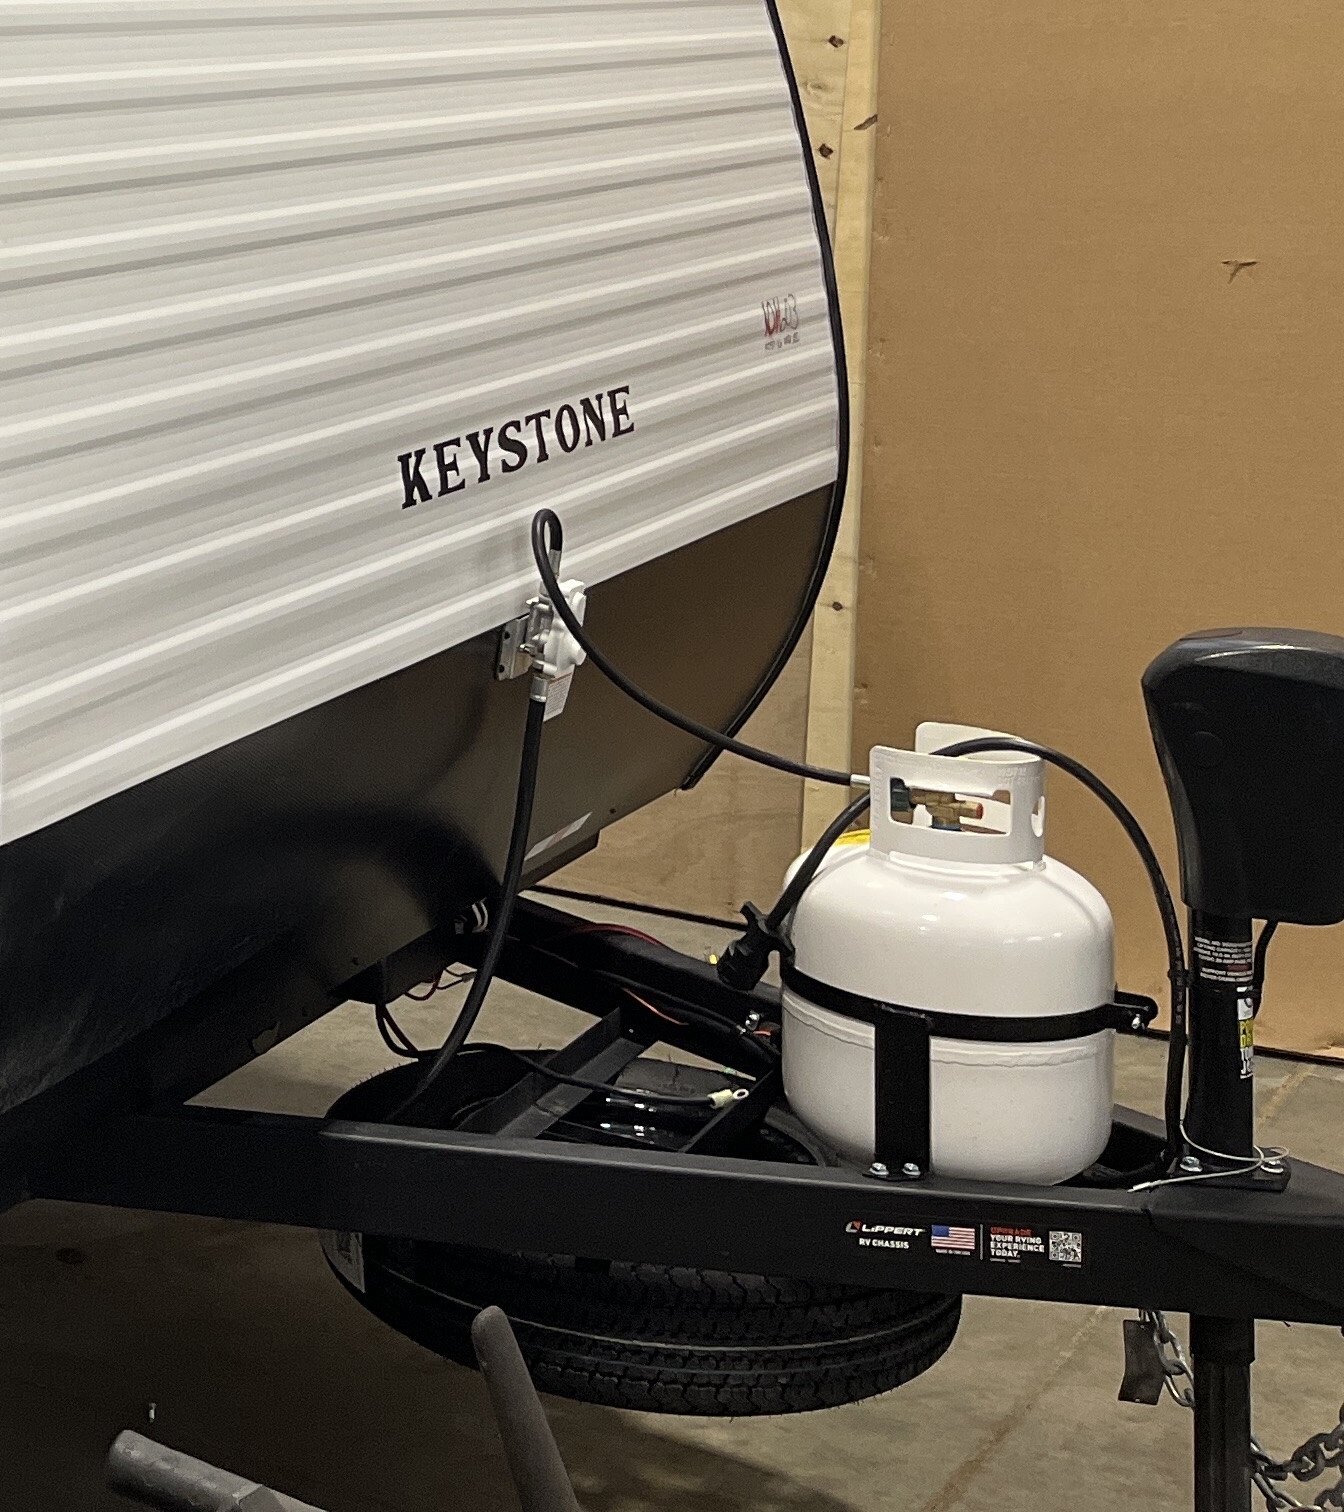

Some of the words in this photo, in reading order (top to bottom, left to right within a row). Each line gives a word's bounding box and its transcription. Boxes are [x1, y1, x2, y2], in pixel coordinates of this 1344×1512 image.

[397, 385, 635, 509] KEYSTONE
[858, 1237, 871, 1247] RV
[872, 1239, 910, 1250] CHASSIS
[990, 1234, 1013, 1243] YOUR
[990, 1241, 1045, 1253] EXPERIENCE
